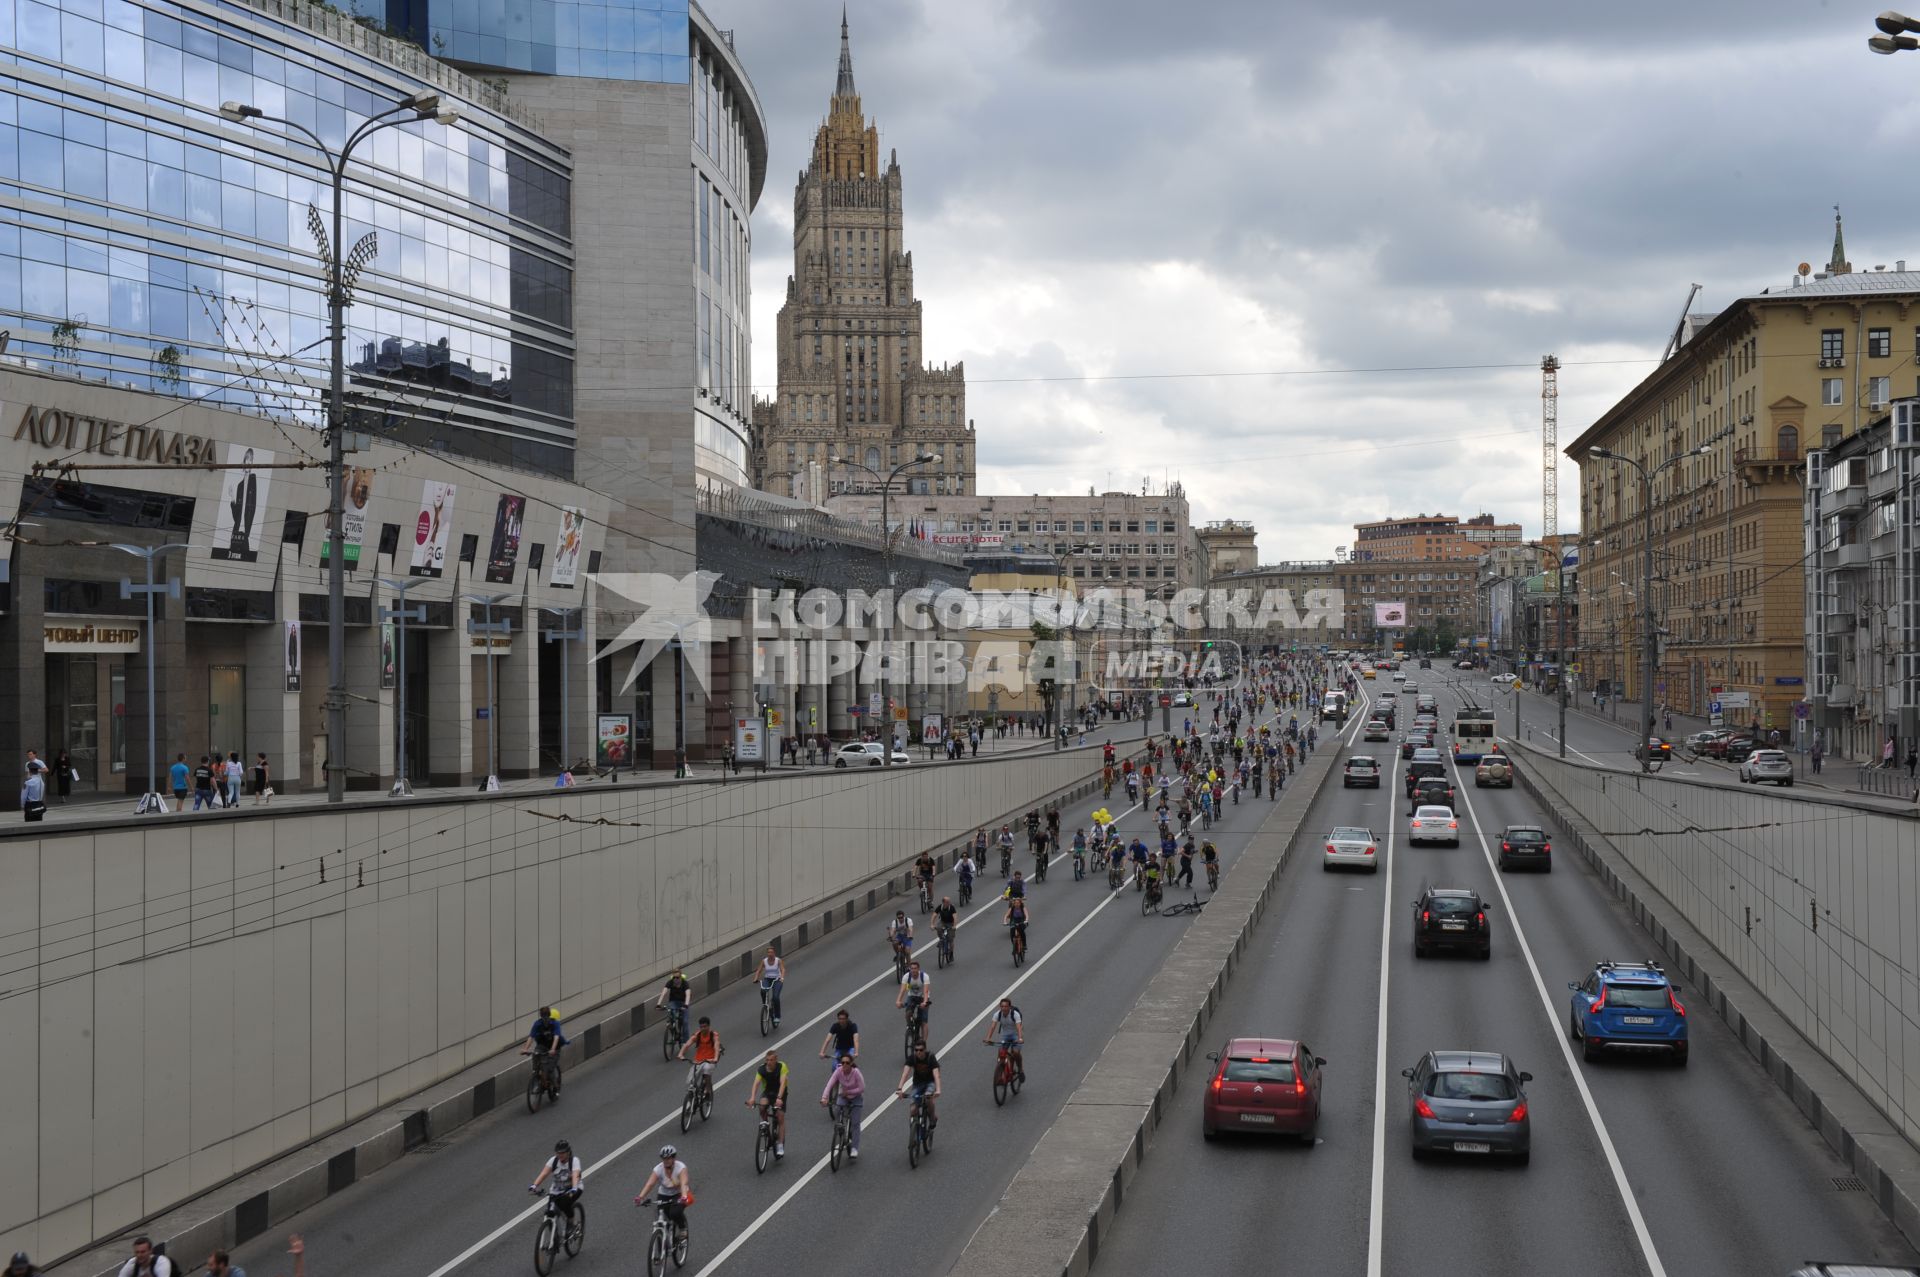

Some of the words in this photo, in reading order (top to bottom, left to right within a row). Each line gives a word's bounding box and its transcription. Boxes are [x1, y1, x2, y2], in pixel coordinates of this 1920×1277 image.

[14, 404, 123, 456] ЛОТТЕ
[124, 424, 217, 465] ПЛАЗА
[97, 629, 139, 644] ЦЕНТР
